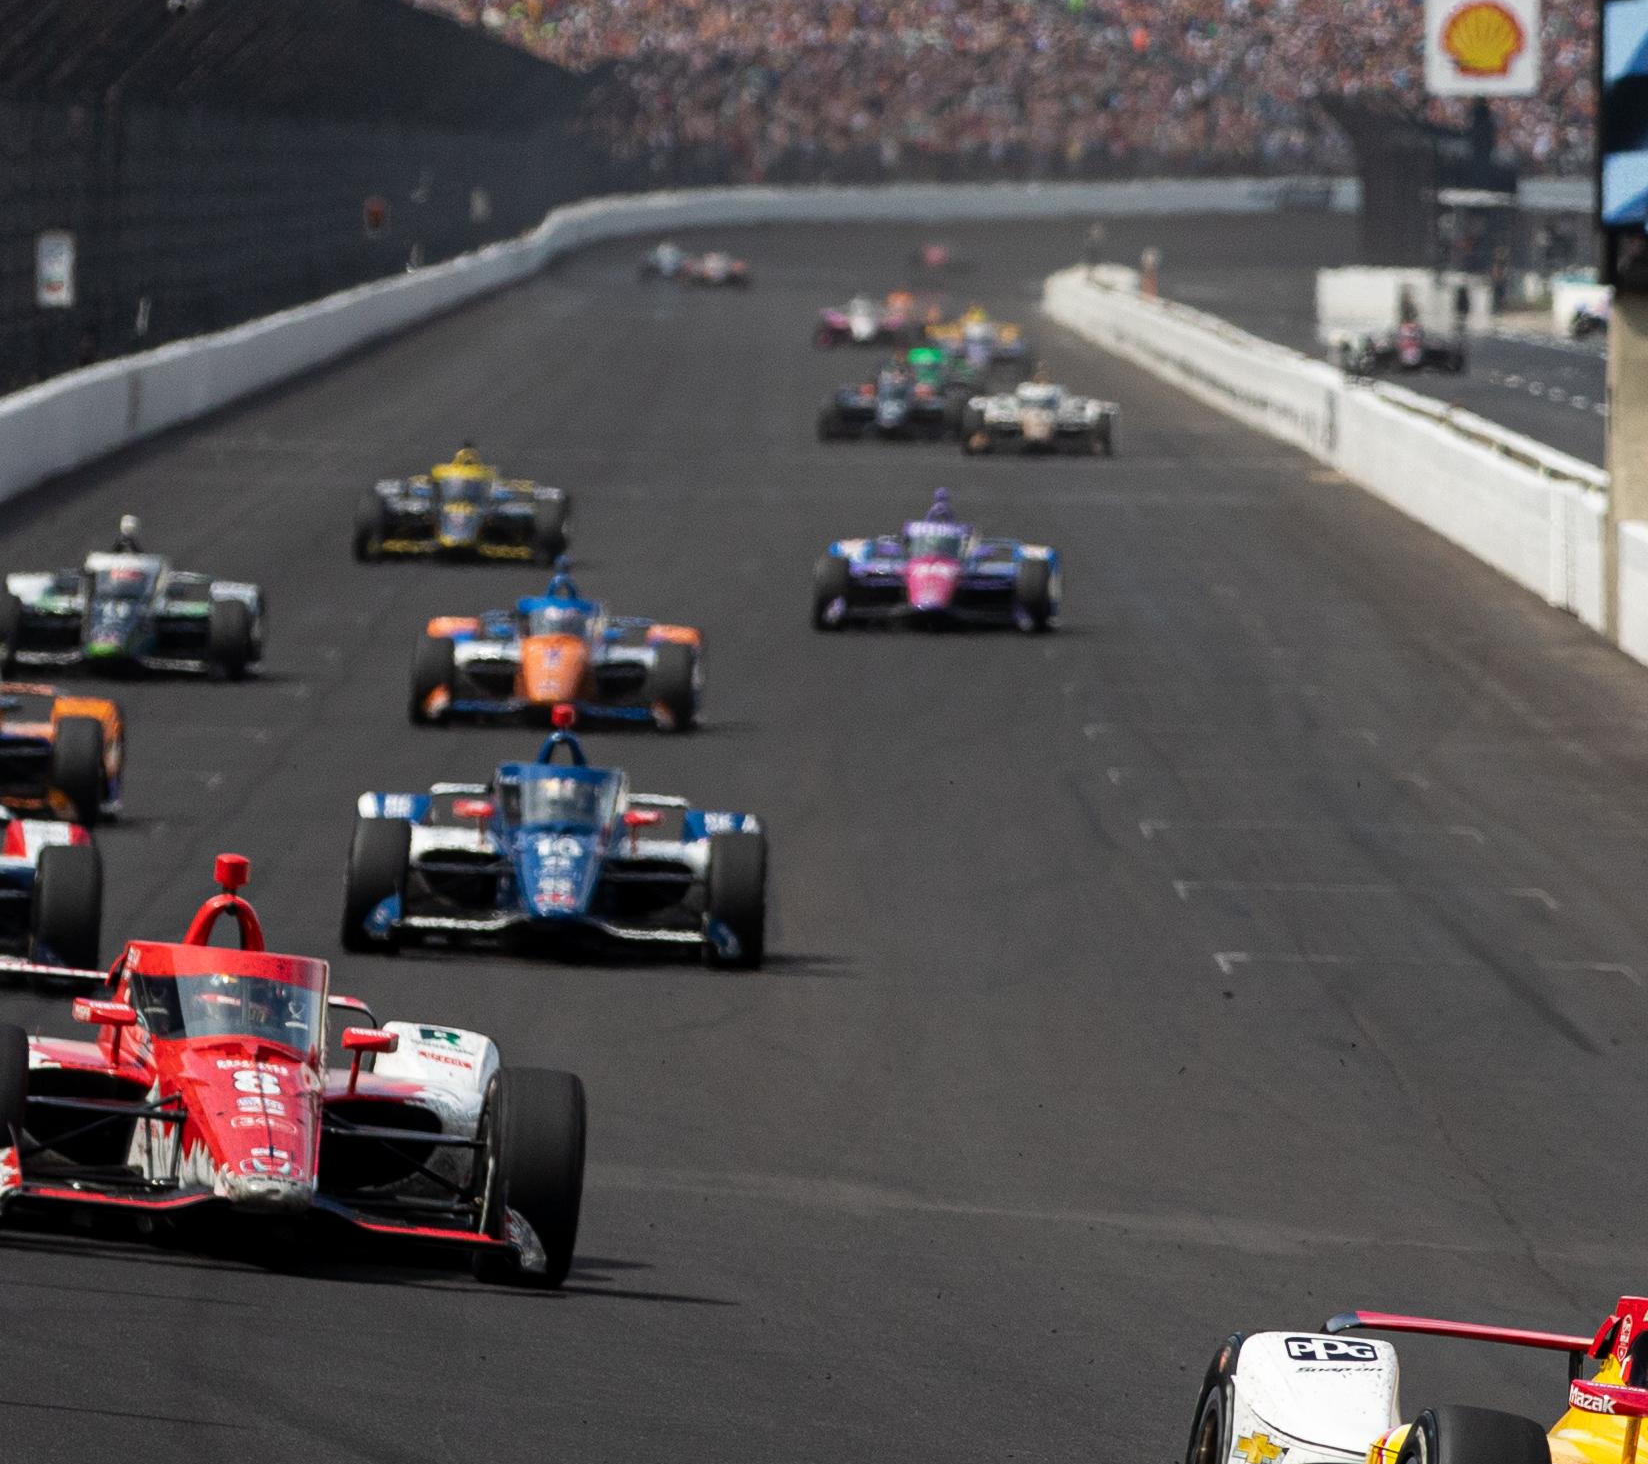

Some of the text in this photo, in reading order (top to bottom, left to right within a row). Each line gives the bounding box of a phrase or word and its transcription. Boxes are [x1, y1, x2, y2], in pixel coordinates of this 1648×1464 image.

[233, 1070, 281, 1095] 8
[1288, 1338, 1375, 1360] PPG
[1569, 1384, 1616, 1414] Mazak
